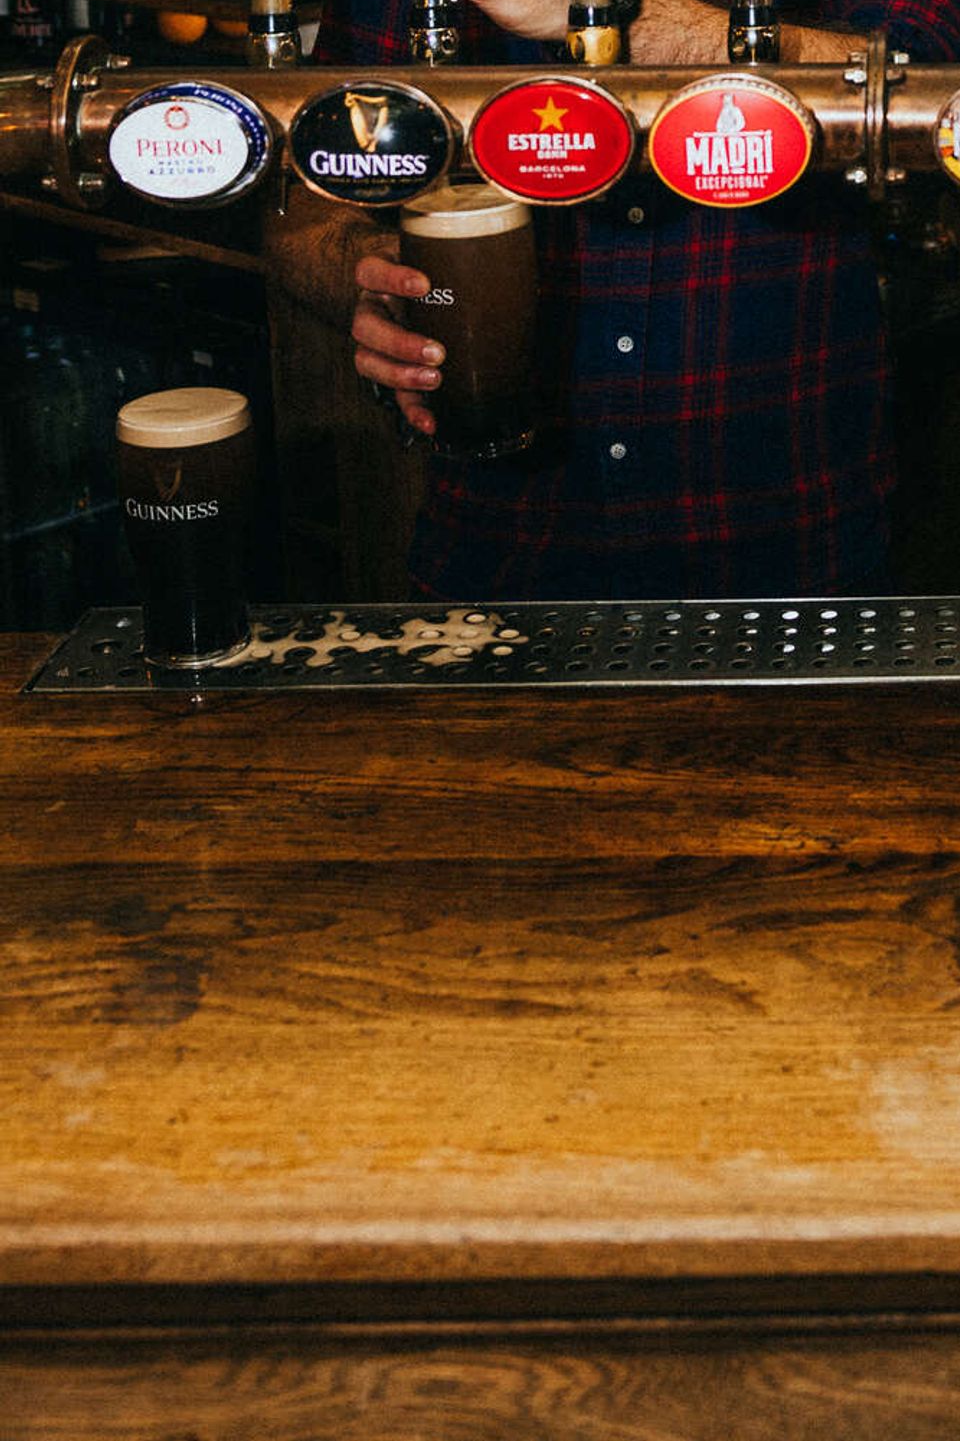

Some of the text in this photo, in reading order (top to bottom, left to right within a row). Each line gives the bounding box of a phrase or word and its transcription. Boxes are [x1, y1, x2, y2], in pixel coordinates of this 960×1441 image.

[136, 138, 222, 158] PERONI
[508, 133, 596, 151] ESTRELLA
[309, 150, 427, 177] GUINNESS
[519, 165, 587, 173] BARCELONA
[695, 175, 766, 190] EXCEPCIONAL
[126, 498, 219, 521] GUINNESS
